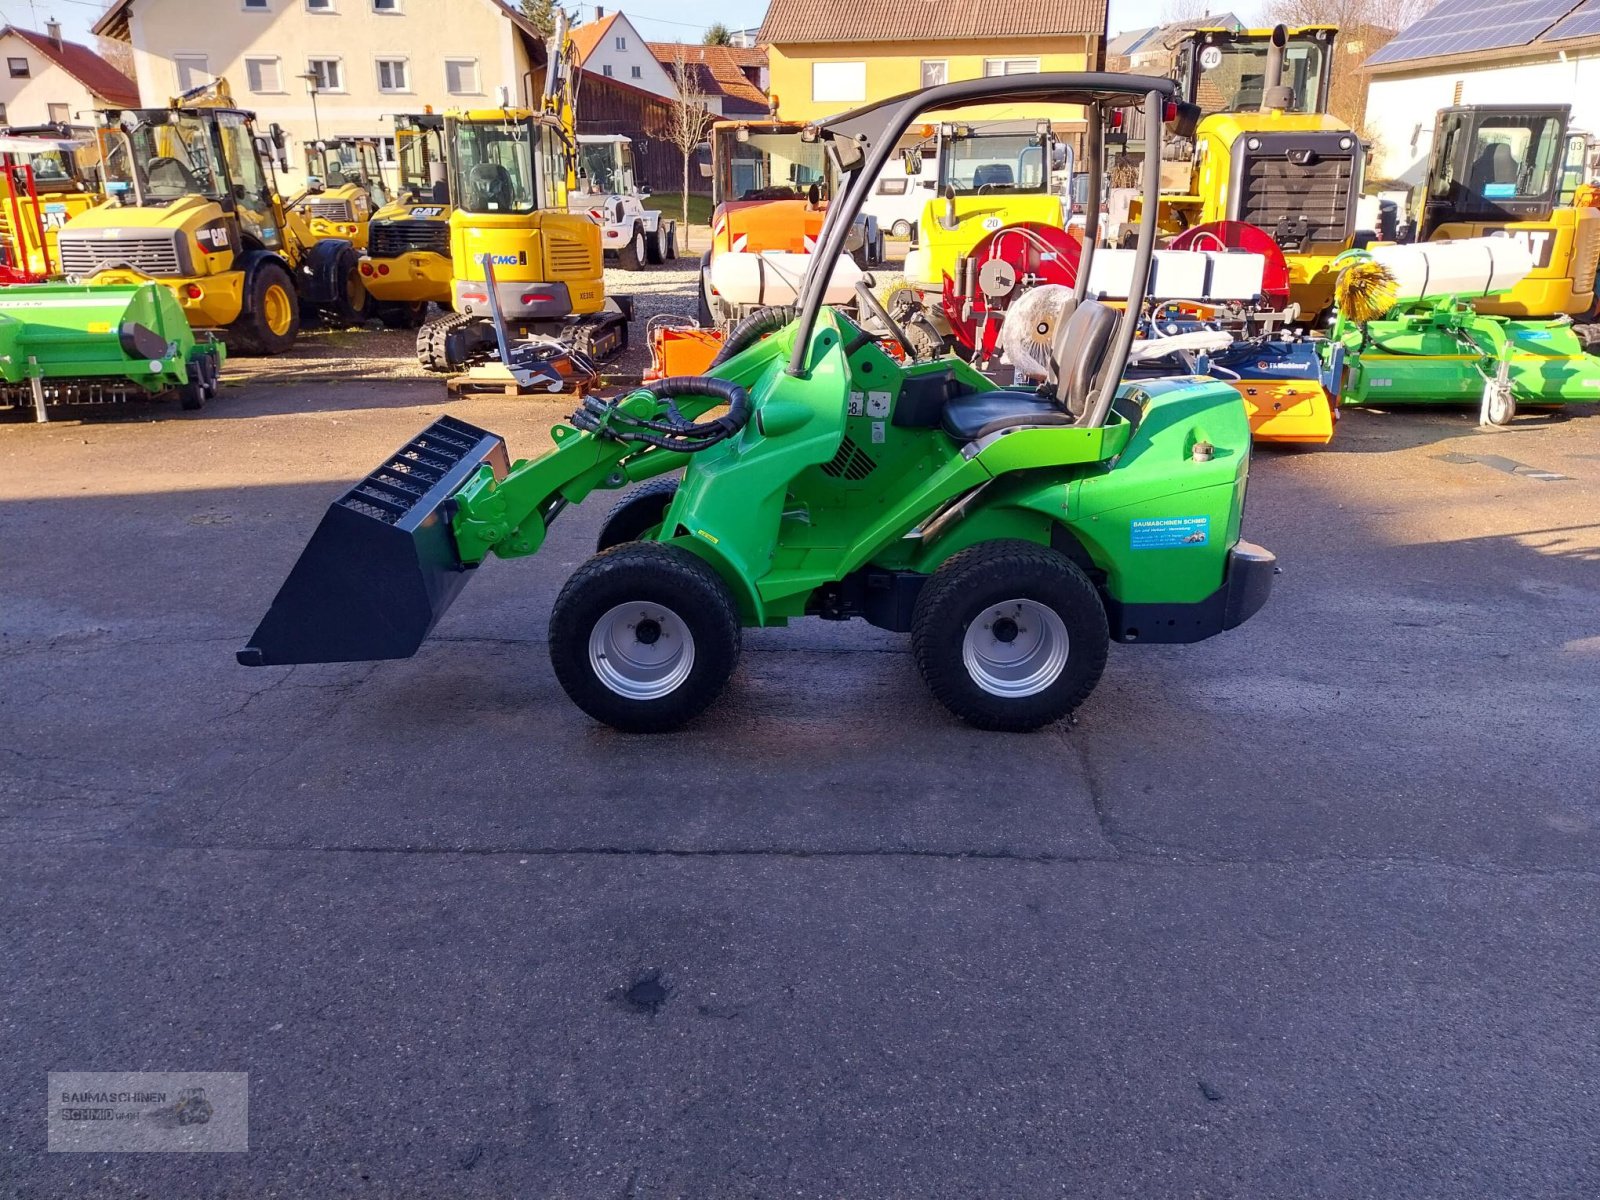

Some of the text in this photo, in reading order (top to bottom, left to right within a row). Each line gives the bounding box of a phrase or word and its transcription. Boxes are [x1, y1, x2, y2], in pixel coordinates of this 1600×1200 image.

[1205, 52, 1218, 64] 20
[411, 207, 442, 217] CAT
[986, 219, 999, 228] 20
[210, 227, 229, 247] CAT
[1133, 517, 1207, 528] BAUMASCHINEN SCHMID
